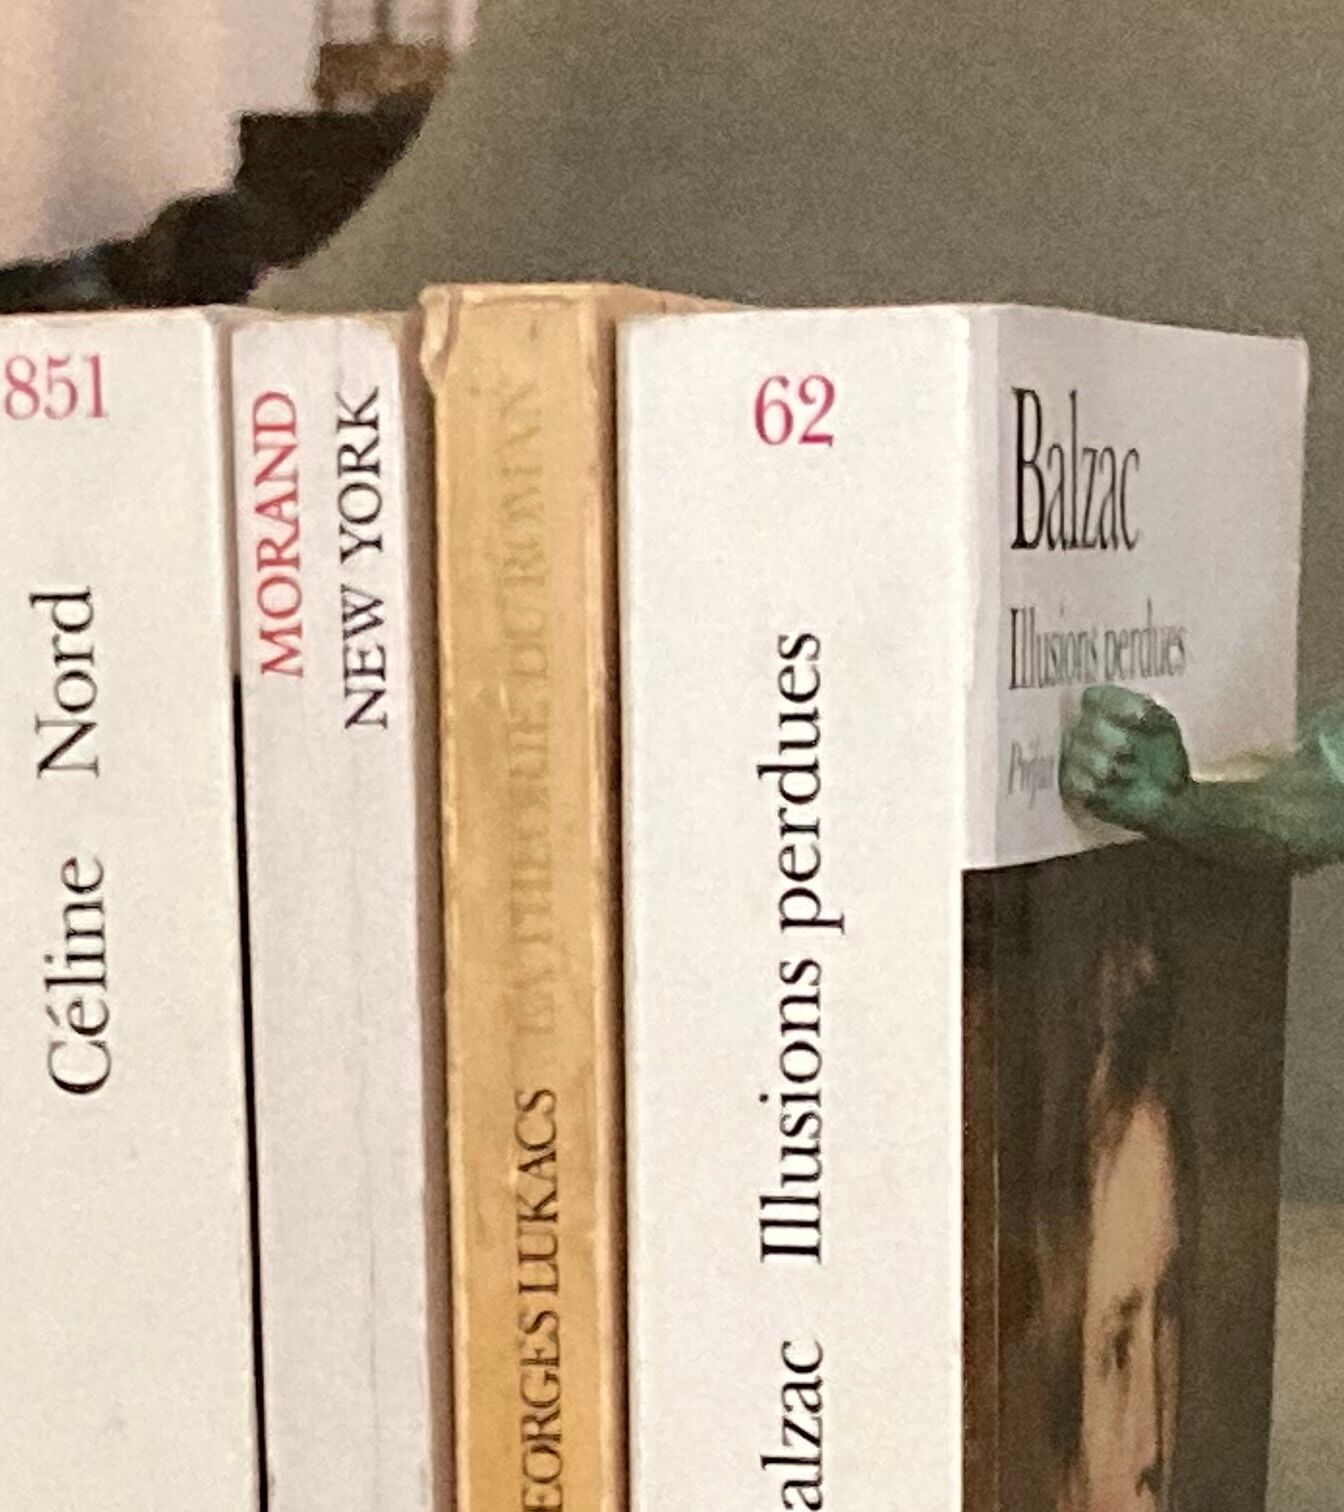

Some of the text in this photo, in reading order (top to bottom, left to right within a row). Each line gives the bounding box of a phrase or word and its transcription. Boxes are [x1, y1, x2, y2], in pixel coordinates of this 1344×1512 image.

[3, 354, 107, 420] 851
[754, 375, 836, 447] 62
[1010, 386, 1140, 552] Balzac
[252, 390, 305, 680] MORAND
[335, 386, 389, 731] NEW YORK
[1008, 597, 1189, 690] Illusions perdues
[28, 586, 112, 1096] Céline Nord
[757, 632, 846, 934] perdues
[513, 1087, 560, 1296] LUKACS
[758, 957, 823, 1263] Illusions
